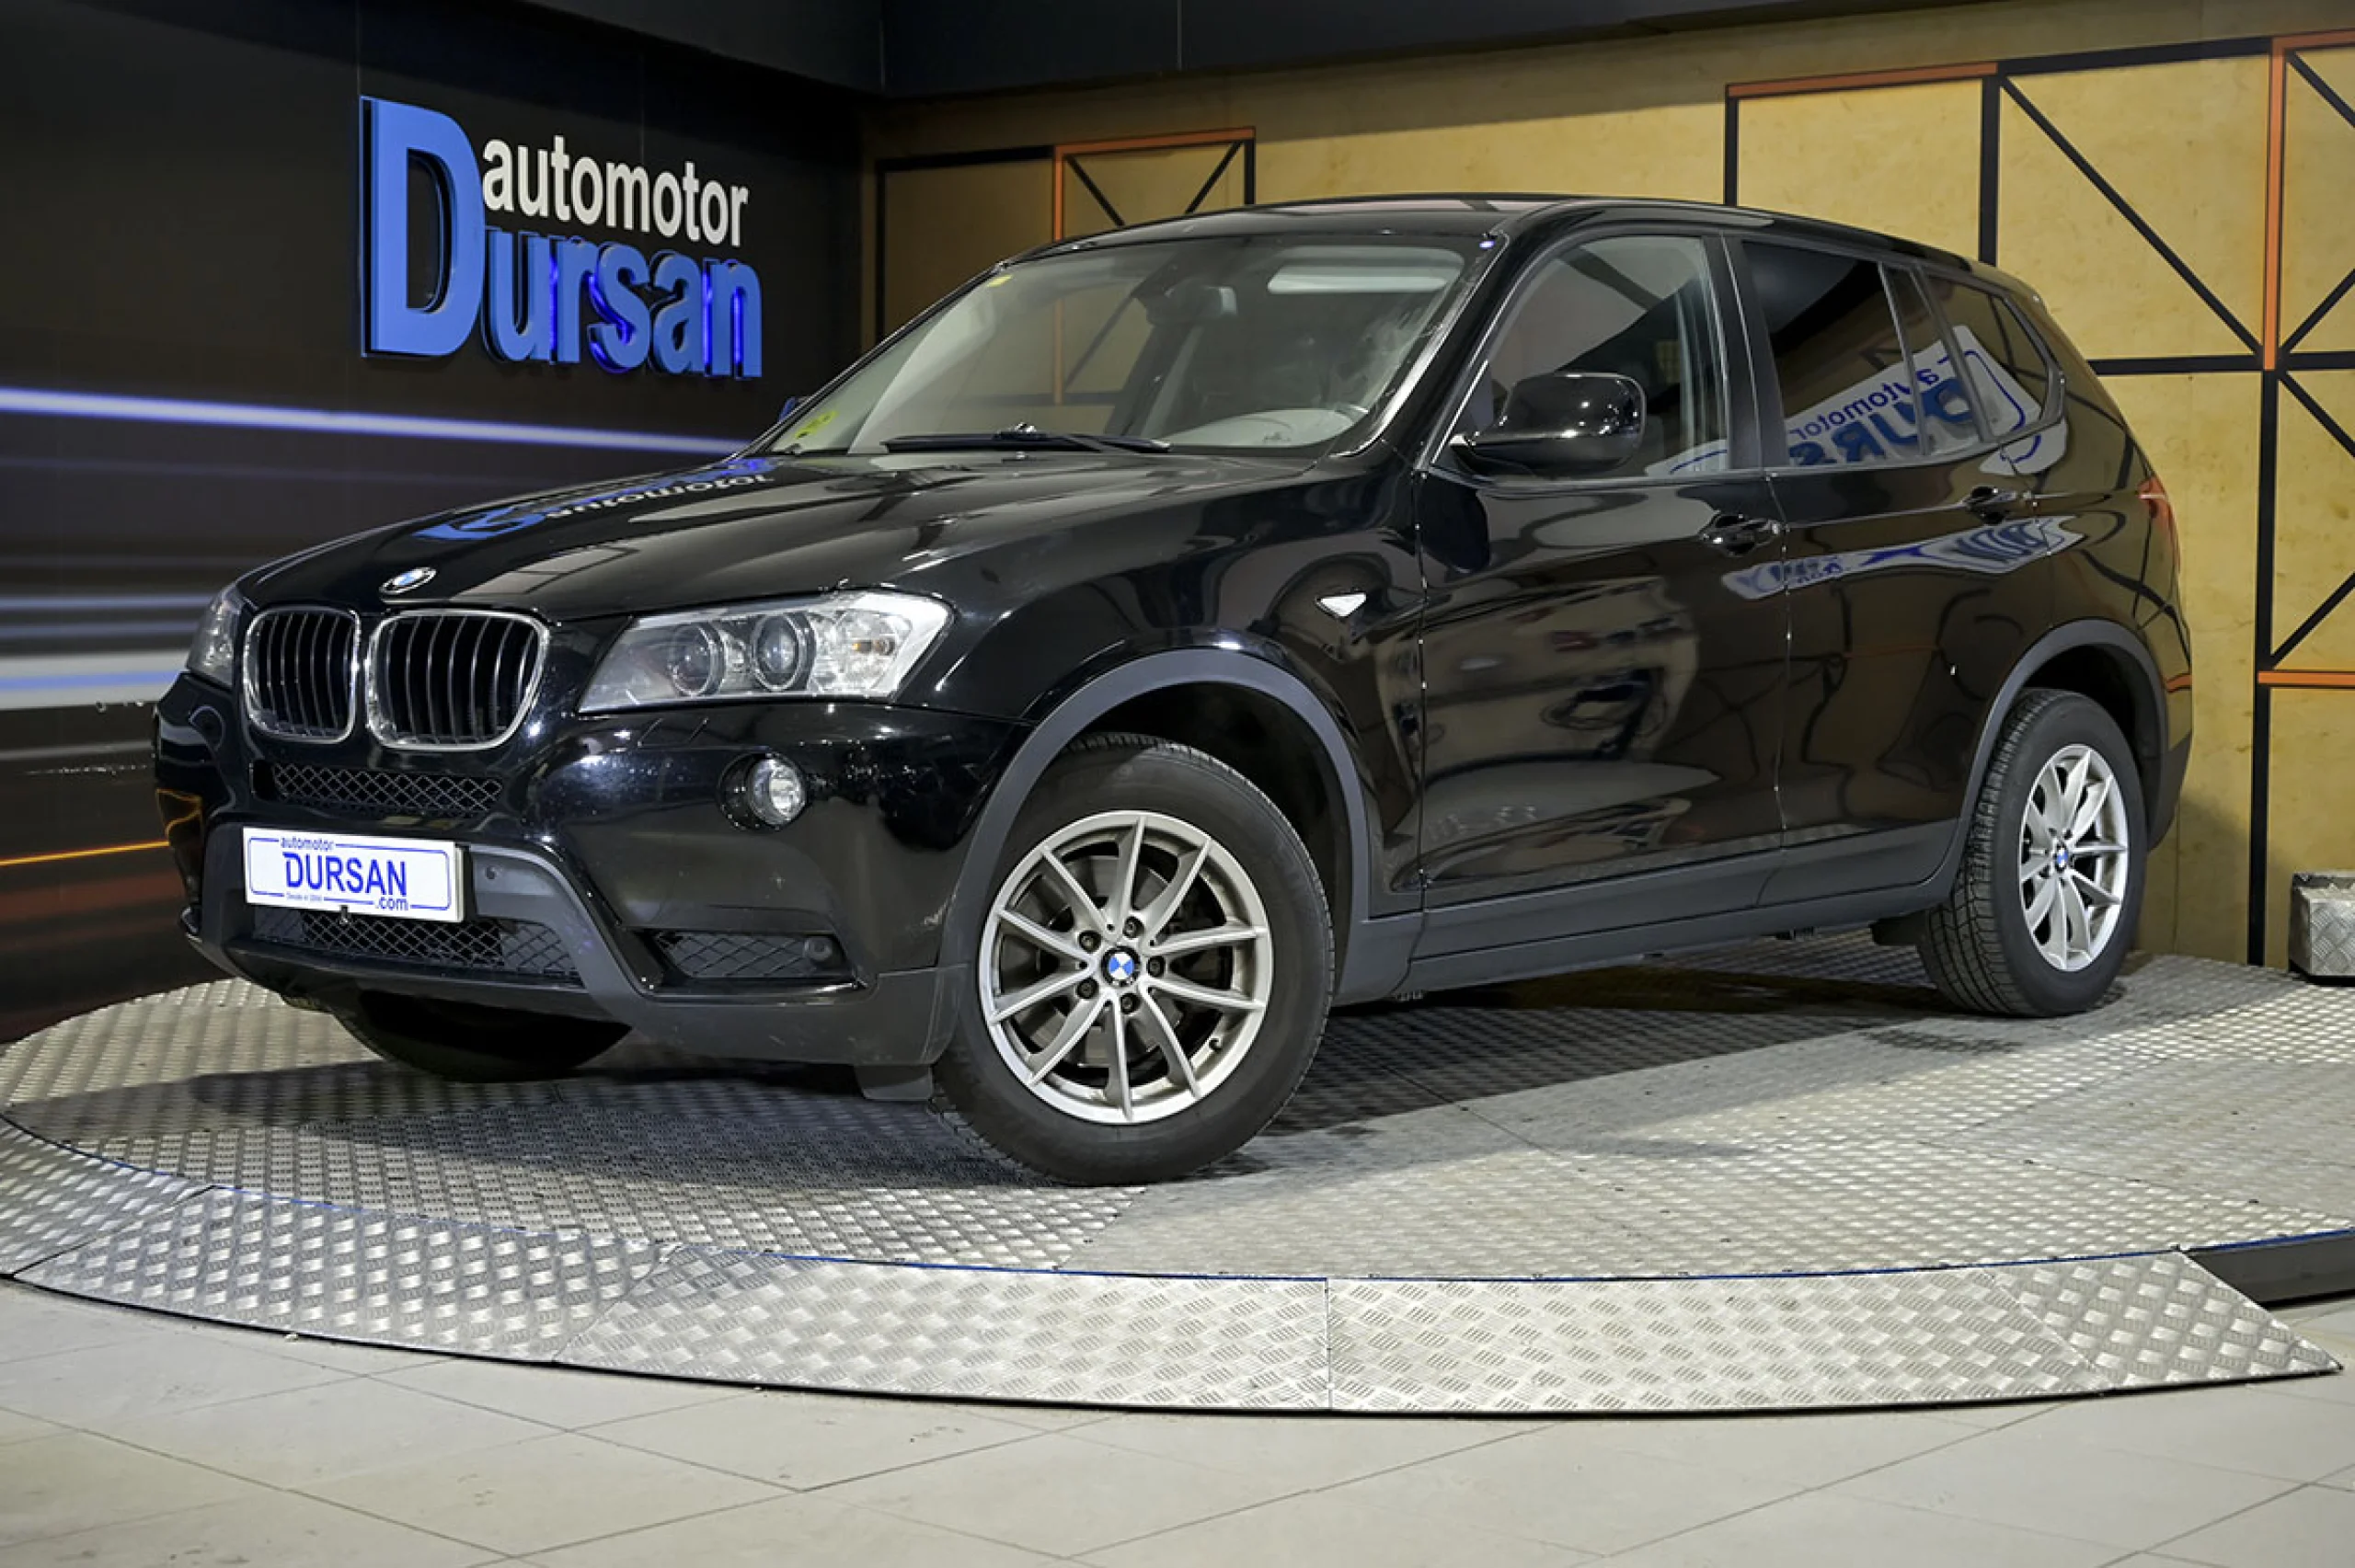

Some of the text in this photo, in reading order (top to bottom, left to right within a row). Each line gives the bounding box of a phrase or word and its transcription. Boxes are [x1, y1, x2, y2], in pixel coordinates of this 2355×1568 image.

[482, 135, 749, 246] automotor
[360, 96, 763, 379] Dursan
[282, 852, 407, 897] DURSAN
[374, 896, 409, 911] .com
